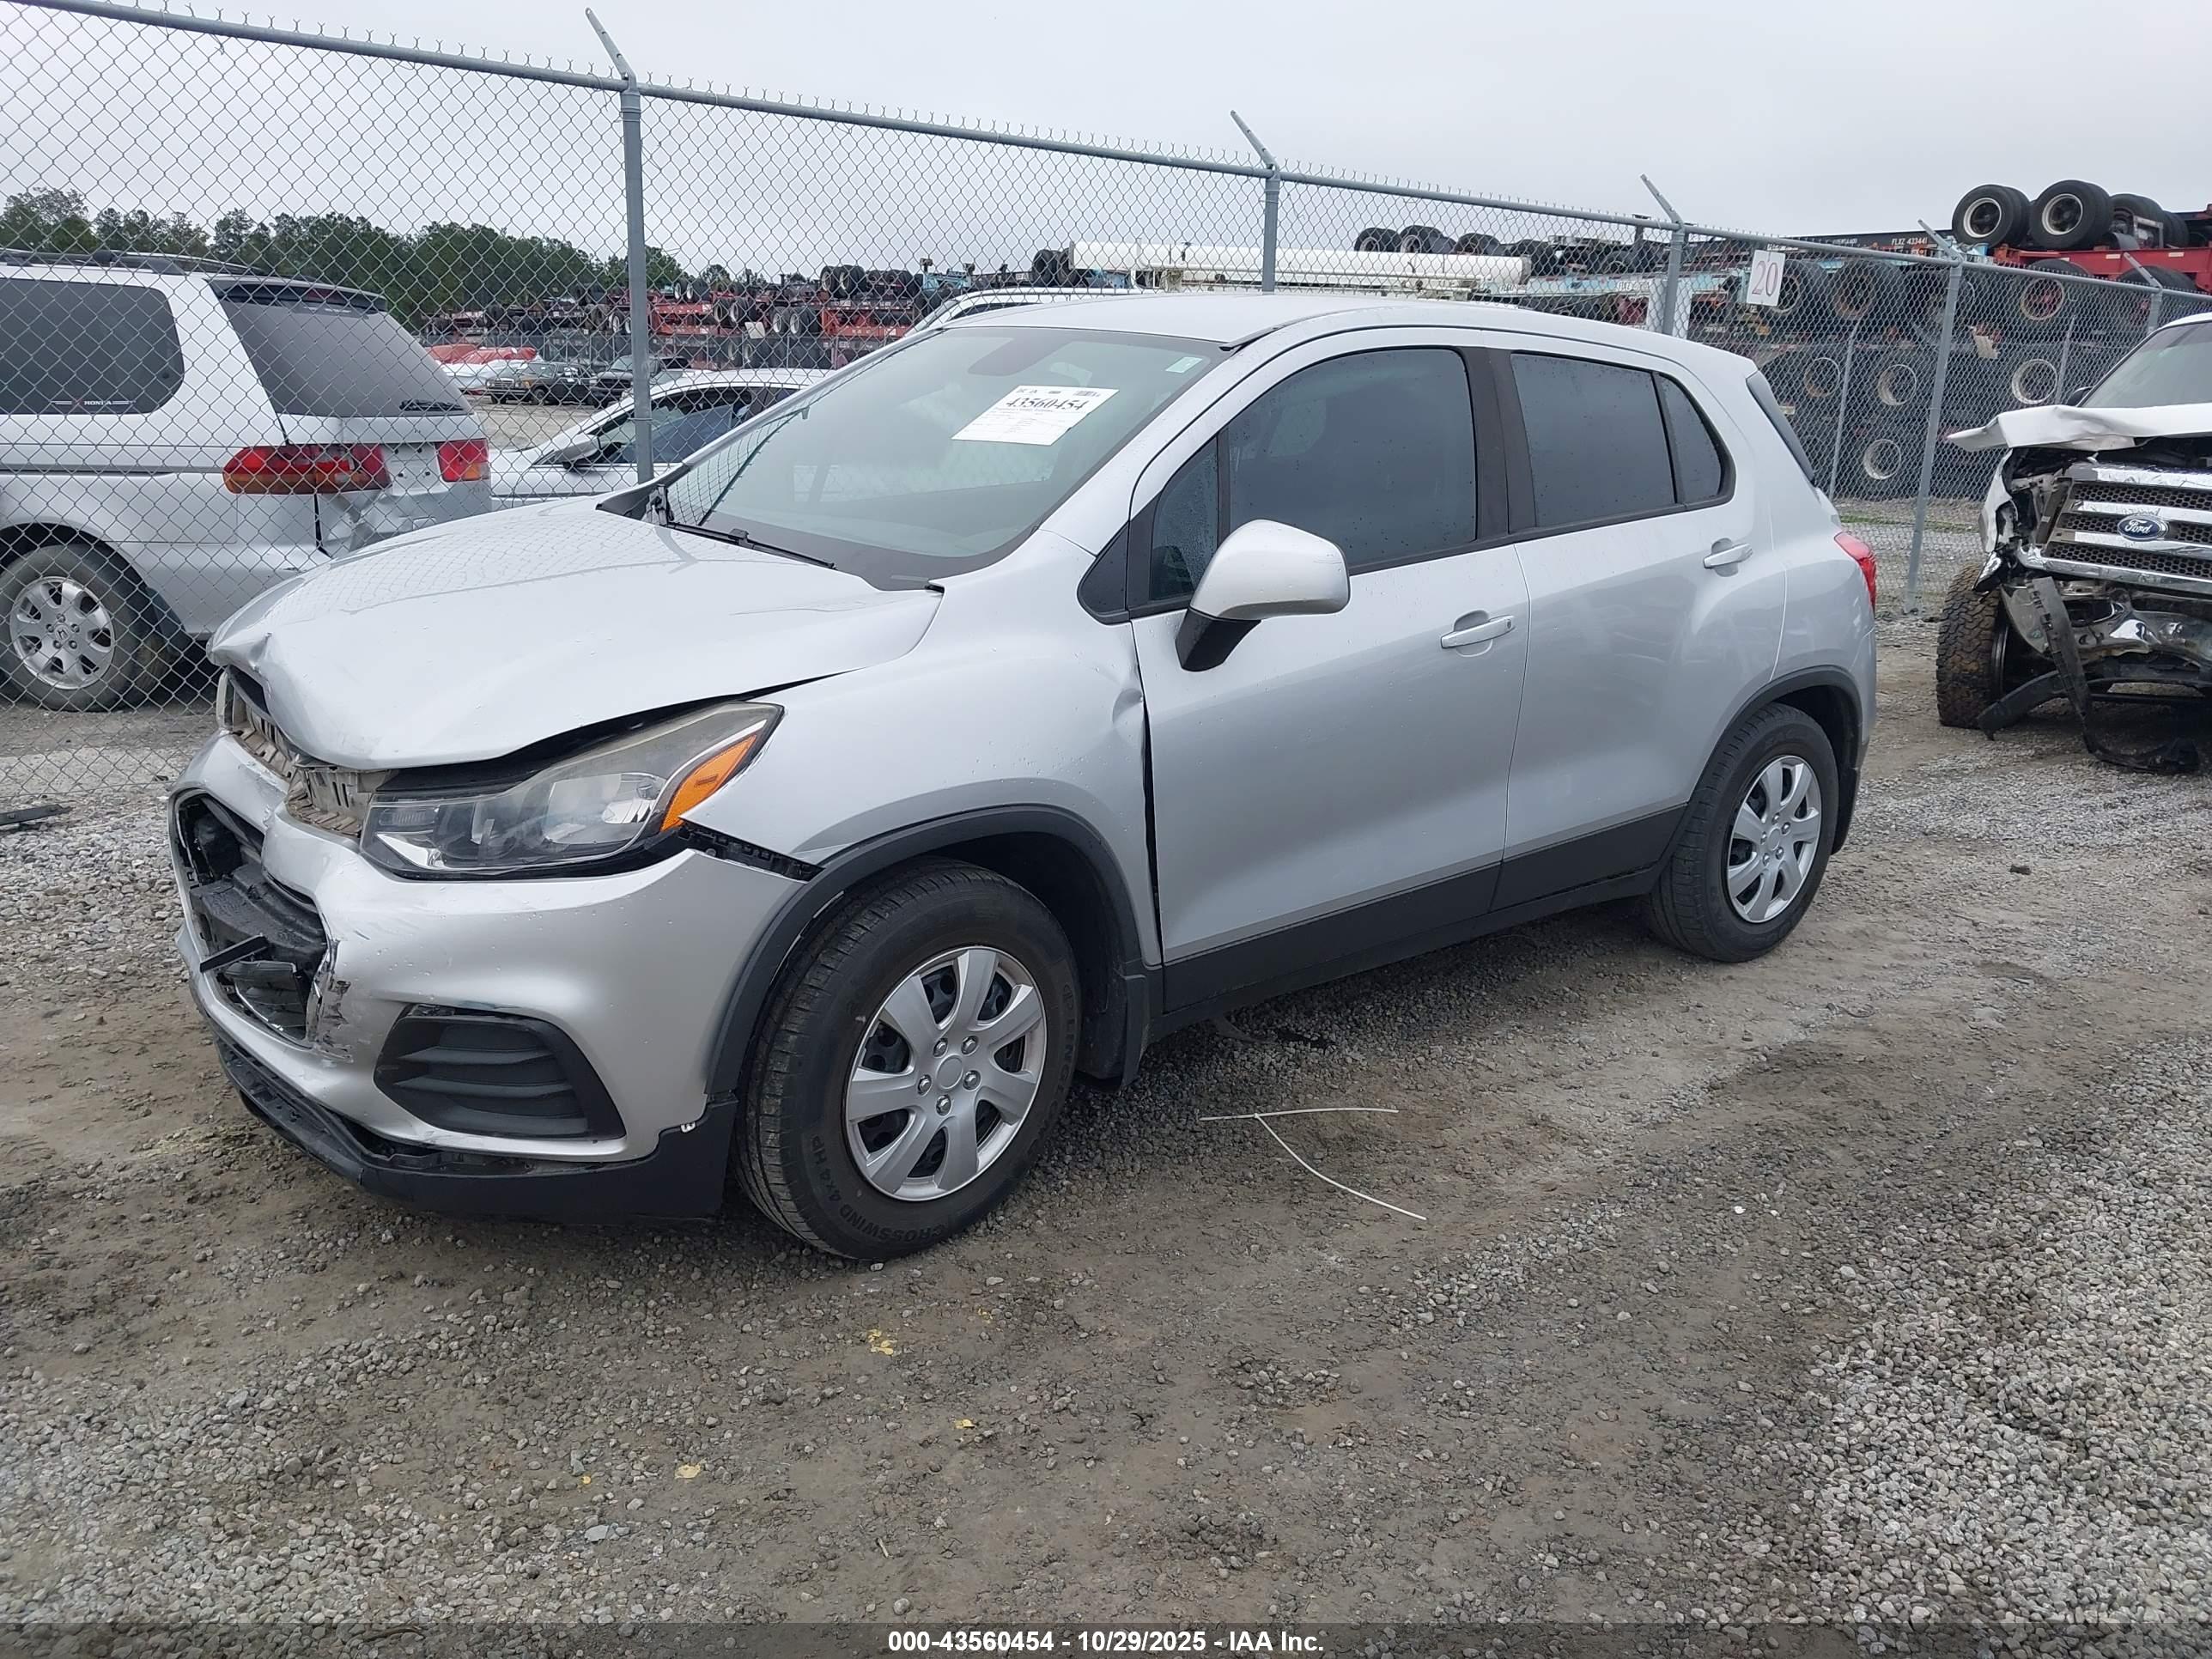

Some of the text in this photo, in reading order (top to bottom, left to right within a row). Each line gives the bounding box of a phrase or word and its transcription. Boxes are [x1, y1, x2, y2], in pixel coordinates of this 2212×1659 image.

[1752, 260, 1778, 296] 20
[1006, 397, 1090, 410] 43560454
[2124, 519, 2153, 533] Ford
[840, 1204, 944, 1243] CROSSWIND
